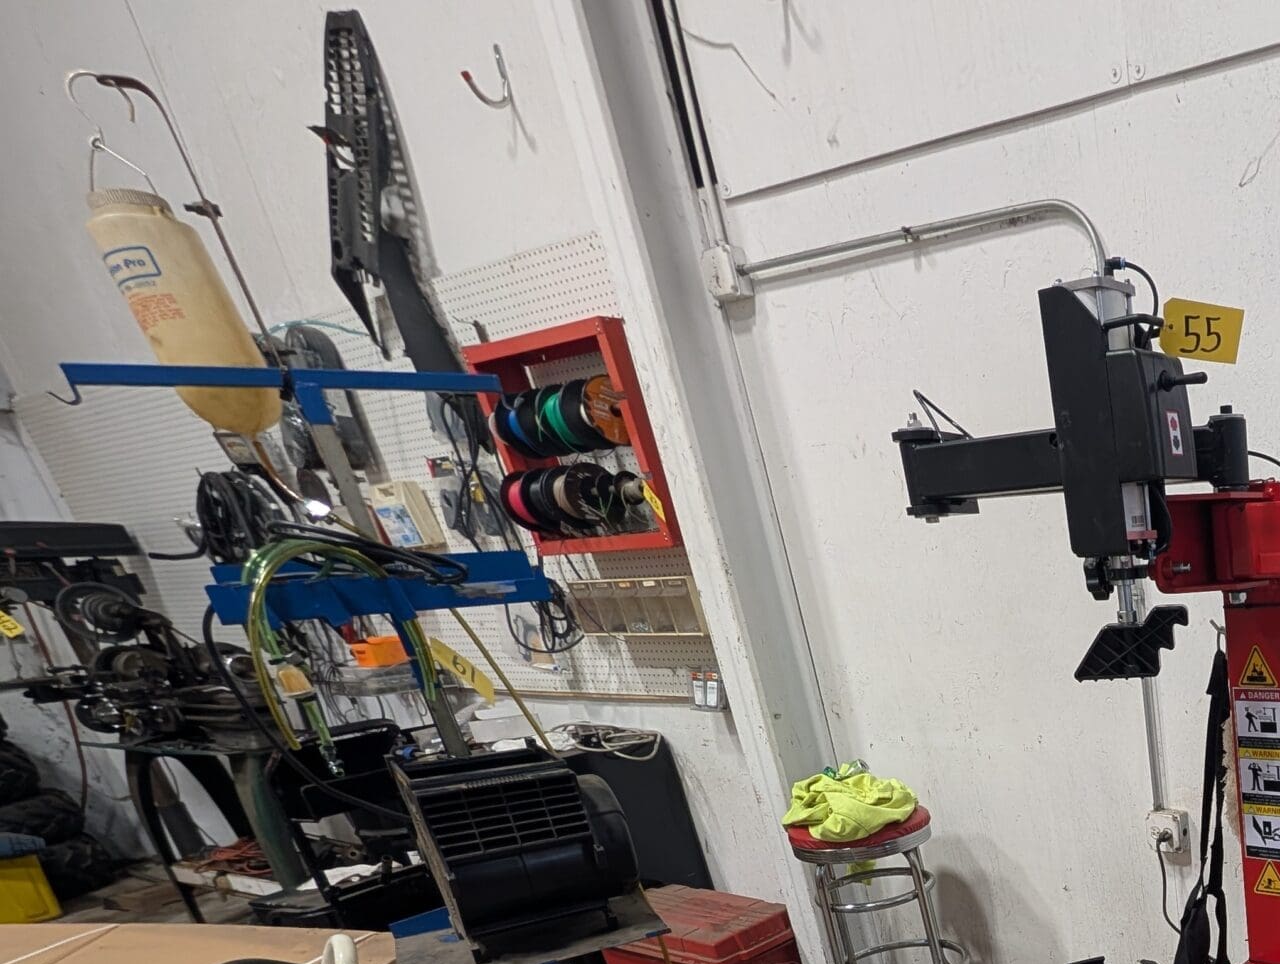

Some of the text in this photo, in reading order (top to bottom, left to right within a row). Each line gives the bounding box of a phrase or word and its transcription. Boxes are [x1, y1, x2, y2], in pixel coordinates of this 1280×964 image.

[1179, 314, 1222, 354] 55
[452, 654, 476, 684] 61
[1247, 691, 1280, 700] DANGER
